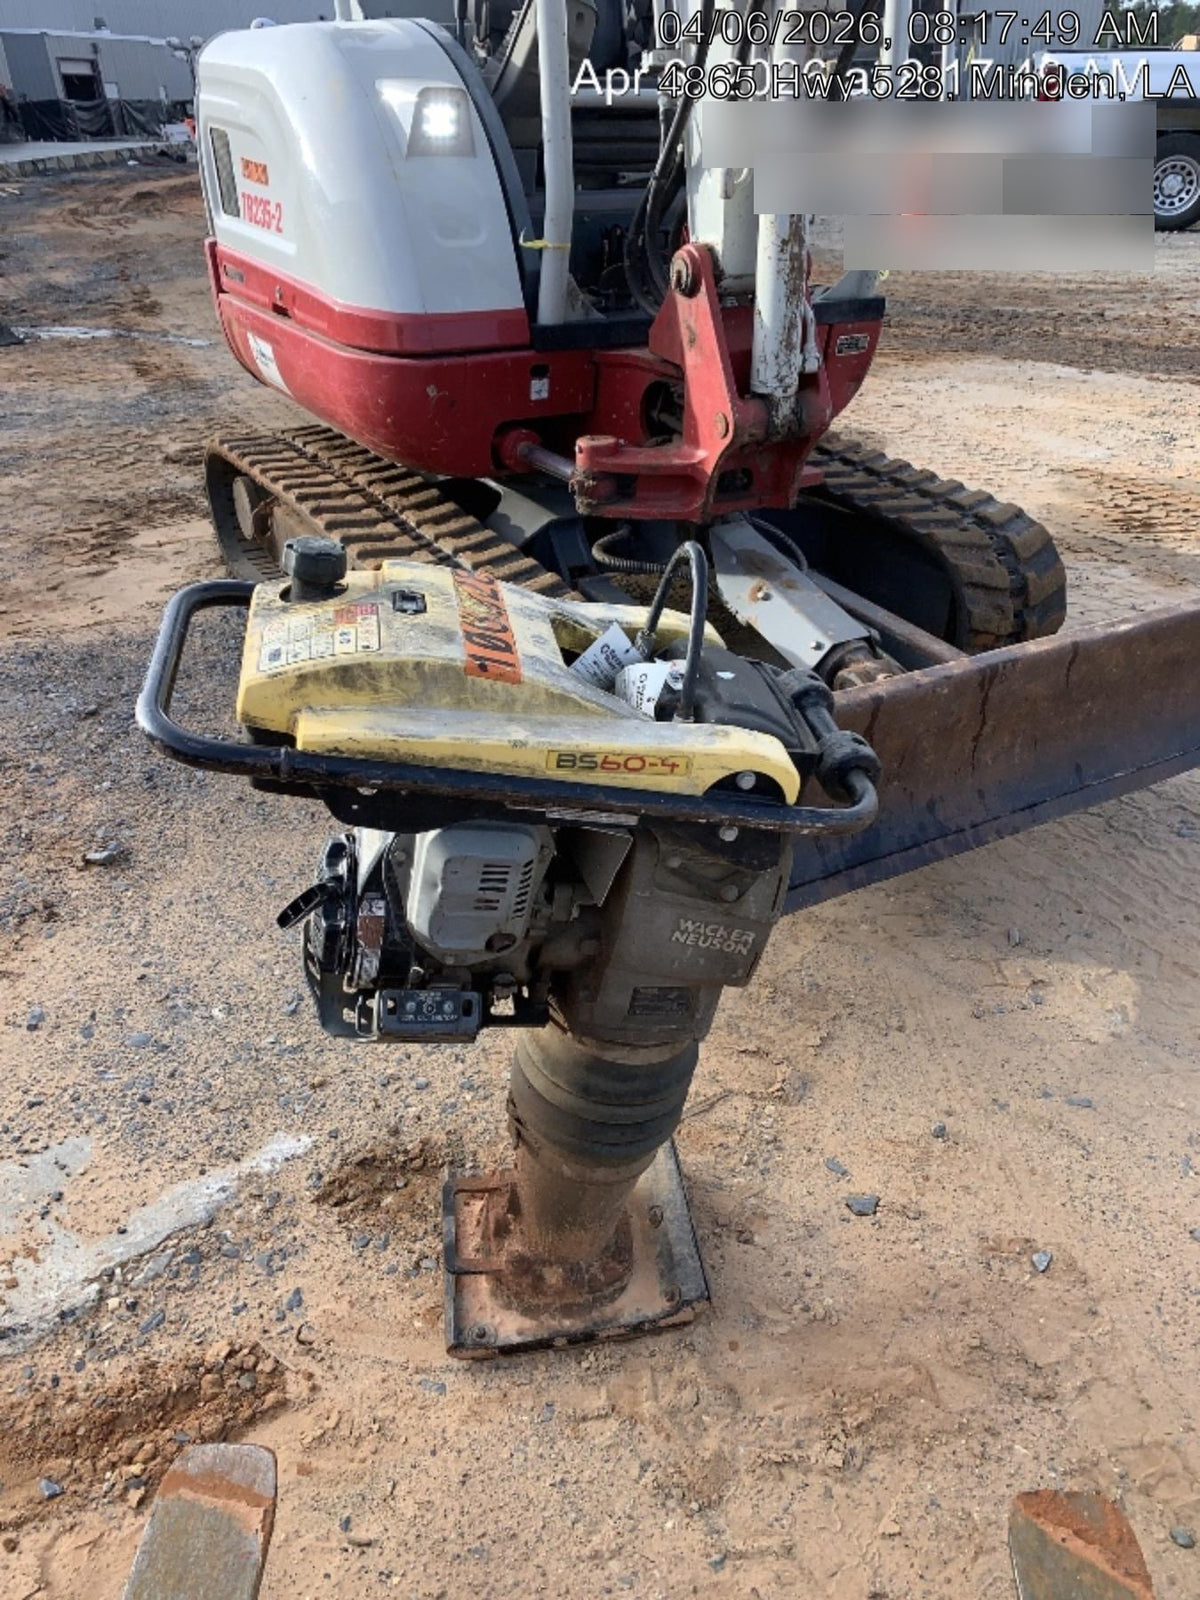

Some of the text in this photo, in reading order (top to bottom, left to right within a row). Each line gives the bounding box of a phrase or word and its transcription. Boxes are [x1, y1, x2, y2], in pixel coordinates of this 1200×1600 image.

[241, 191, 284, 234] TB235-2
[556, 752, 680, 774] BS60-4
[671, 930, 750, 956] NEUSON
